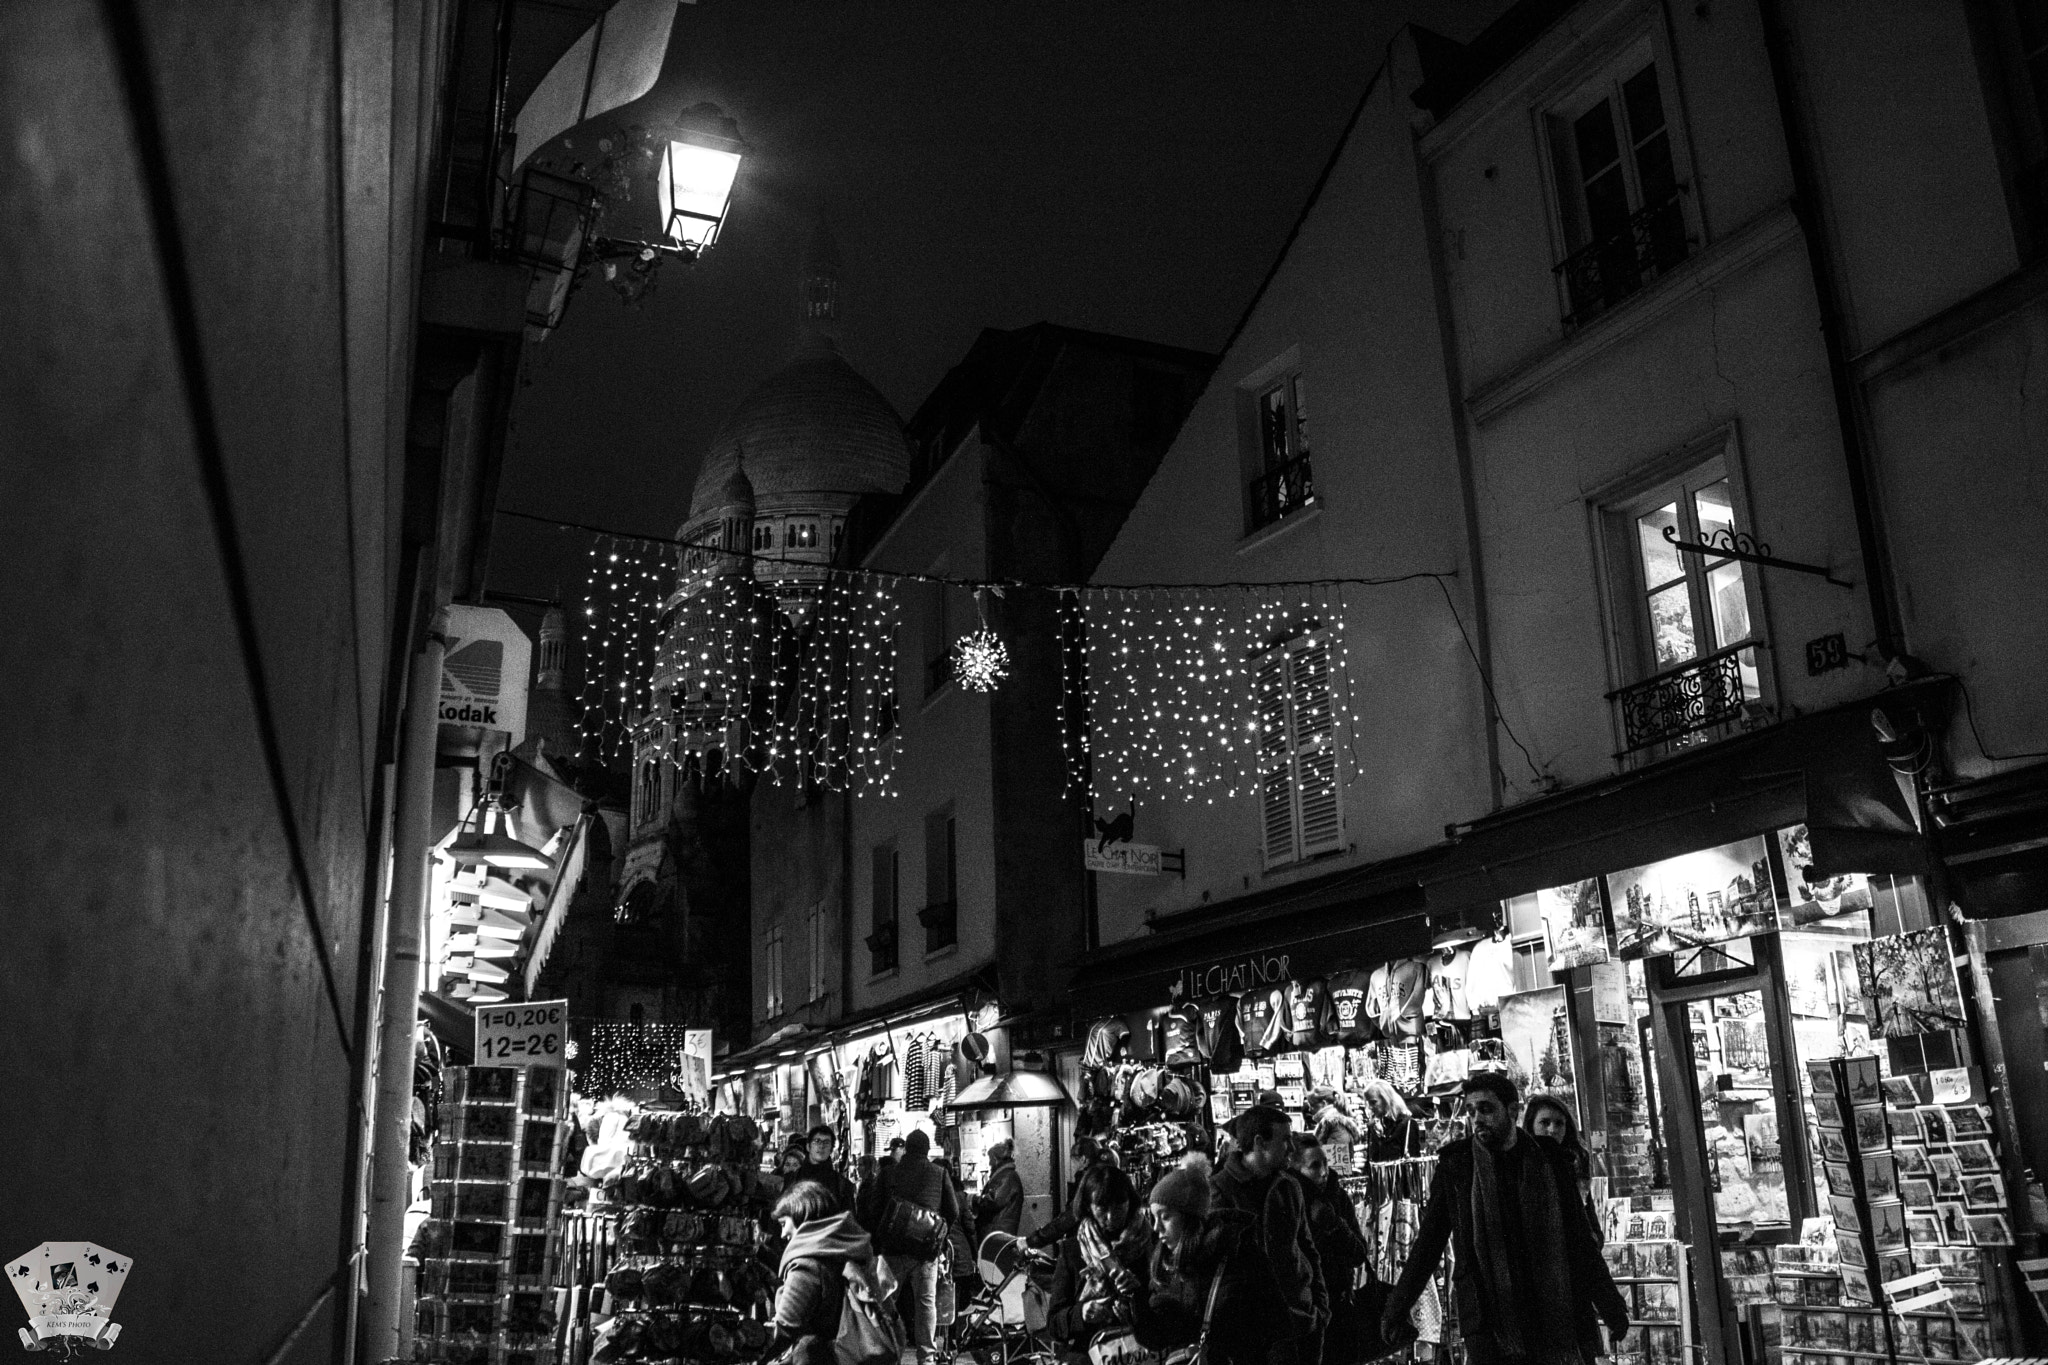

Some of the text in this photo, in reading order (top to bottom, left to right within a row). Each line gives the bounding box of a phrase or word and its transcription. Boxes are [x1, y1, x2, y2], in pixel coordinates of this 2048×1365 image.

[1811, 638, 1841, 669] 59
[439, 701, 497, 724] Kodak
[1190, 955, 1293, 998] LE CHAT NOIR
